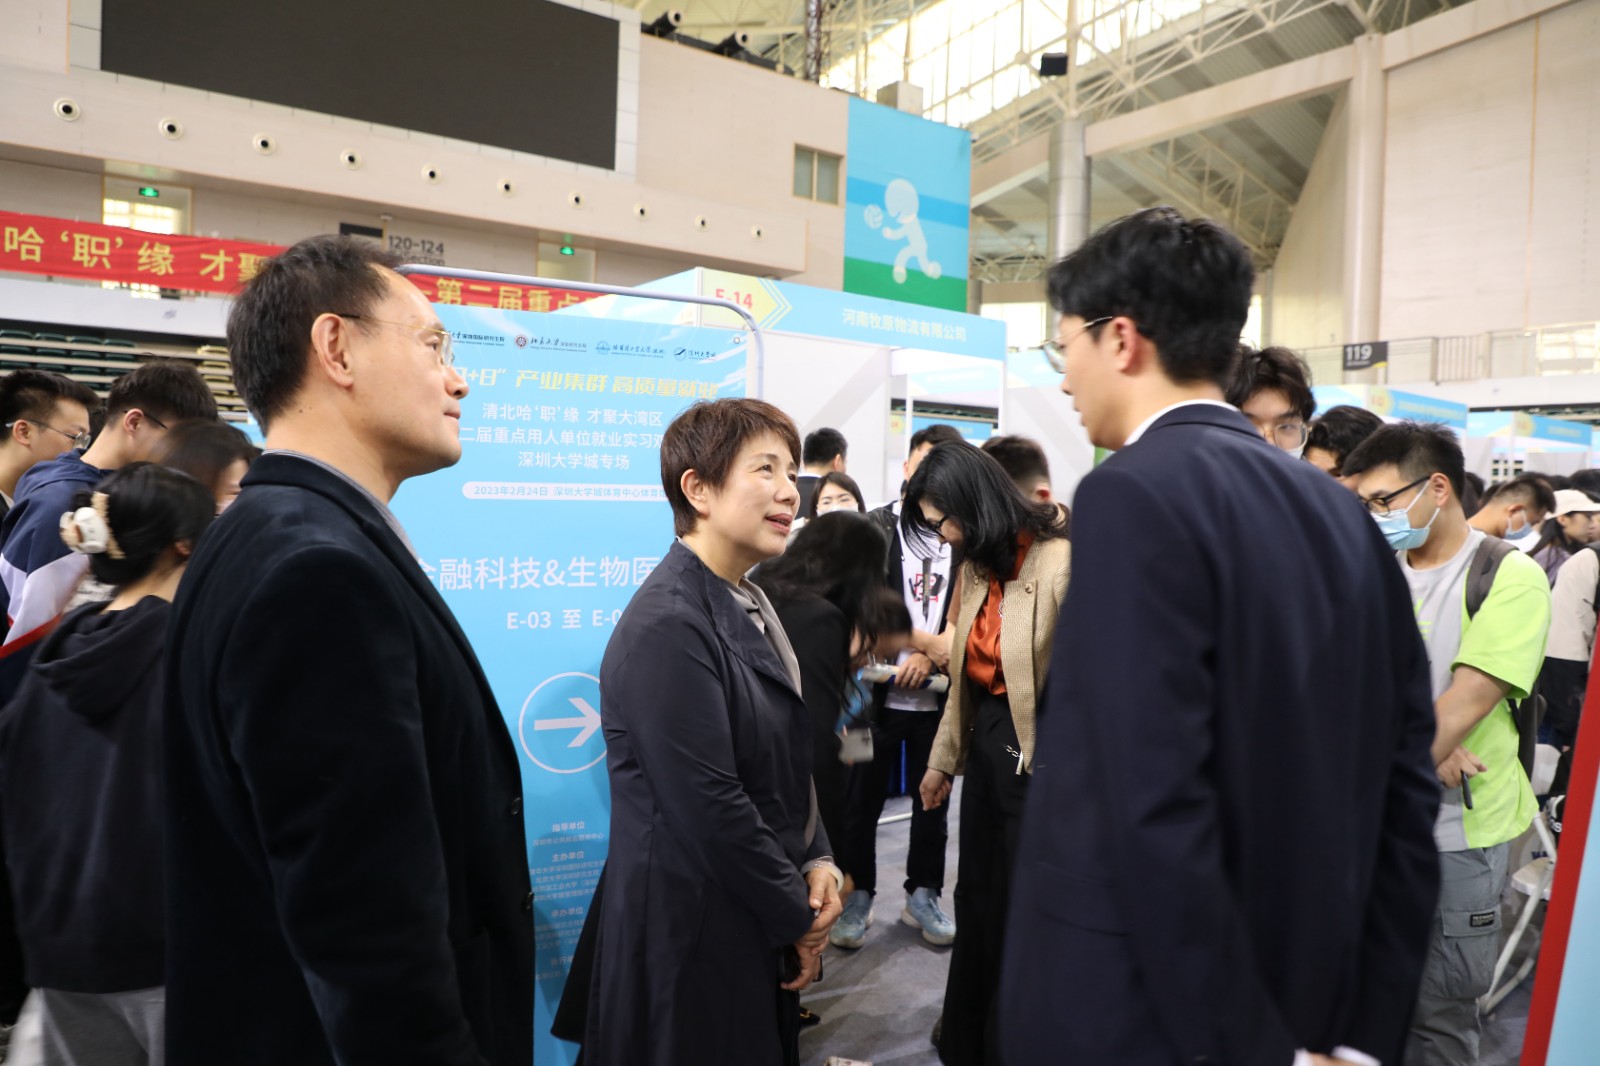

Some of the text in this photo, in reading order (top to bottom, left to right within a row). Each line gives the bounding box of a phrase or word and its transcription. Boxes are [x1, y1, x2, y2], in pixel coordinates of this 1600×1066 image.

[388, 235, 444, 254] 120-124
[843, 308, 967, 342] 河南牧原物流有限公司
[1346, 344, 1372, 360] 119
[515, 368, 608, 394] 产业集群
[586, 407, 664, 427] 才聚大湾区
[518, 451, 630, 470] 深圳大学城专场
[474, 485, 548, 497] 2023年2月24日
[507, 611, 552, 629] E-03
[561, 608, 582, 629] 至
